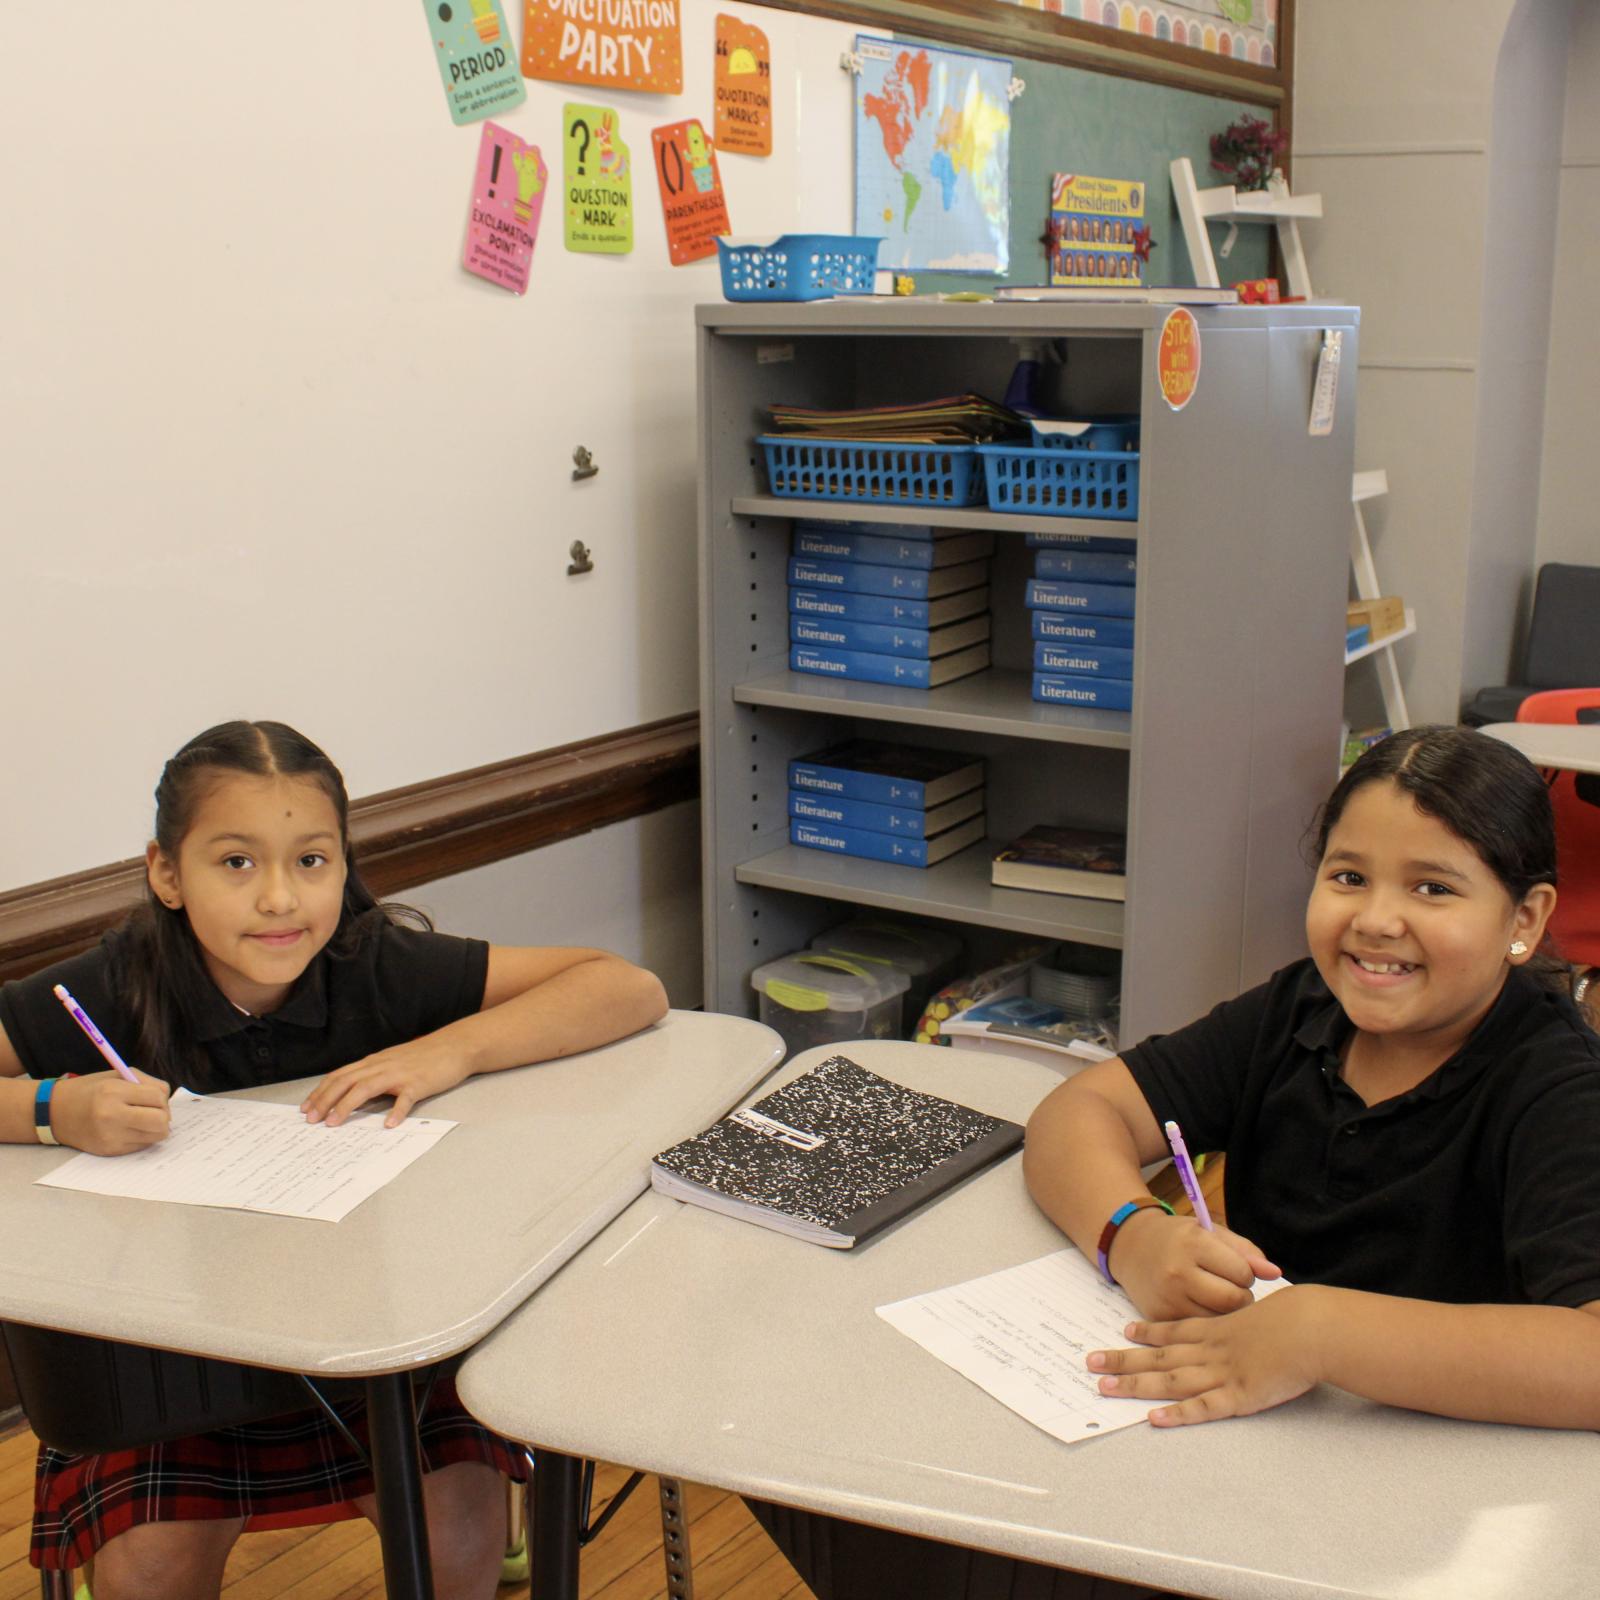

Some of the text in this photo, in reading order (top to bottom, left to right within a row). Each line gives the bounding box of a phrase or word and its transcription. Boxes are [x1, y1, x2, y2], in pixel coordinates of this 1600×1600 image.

[558, 20, 653, 76] PARTY
[449, 46, 506, 84] PERIOD
[717, 87, 769, 108] QUOTATION
[727, 107, 760, 125] MARKS
[570, 188, 628, 207] QUESTION
[1066, 188, 1127, 213] Presidents
[666, 194, 724, 221] PARENTHESES
[583, 208, 616, 227] MARK
[472, 208, 534, 249] EXCLAMATION
[489, 232, 517, 256] POINT
[1171, 348, 1189, 368] with
[801, 540, 850, 556] Literature
[795, 567, 844, 584] Literature
[796, 597, 845, 614] Literature
[1033, 591, 1088, 607] Literature
[797, 627, 846, 643] Literature
[1040, 622, 1096, 638] Literature
[797, 656, 847, 673] Literature
[1043, 653, 1099, 670] Literature
[1040, 684, 1096, 701] Literature
[795, 773, 844, 792] Literature
[795, 802, 843, 821] Literature
[797, 829, 846, 849] Literature
